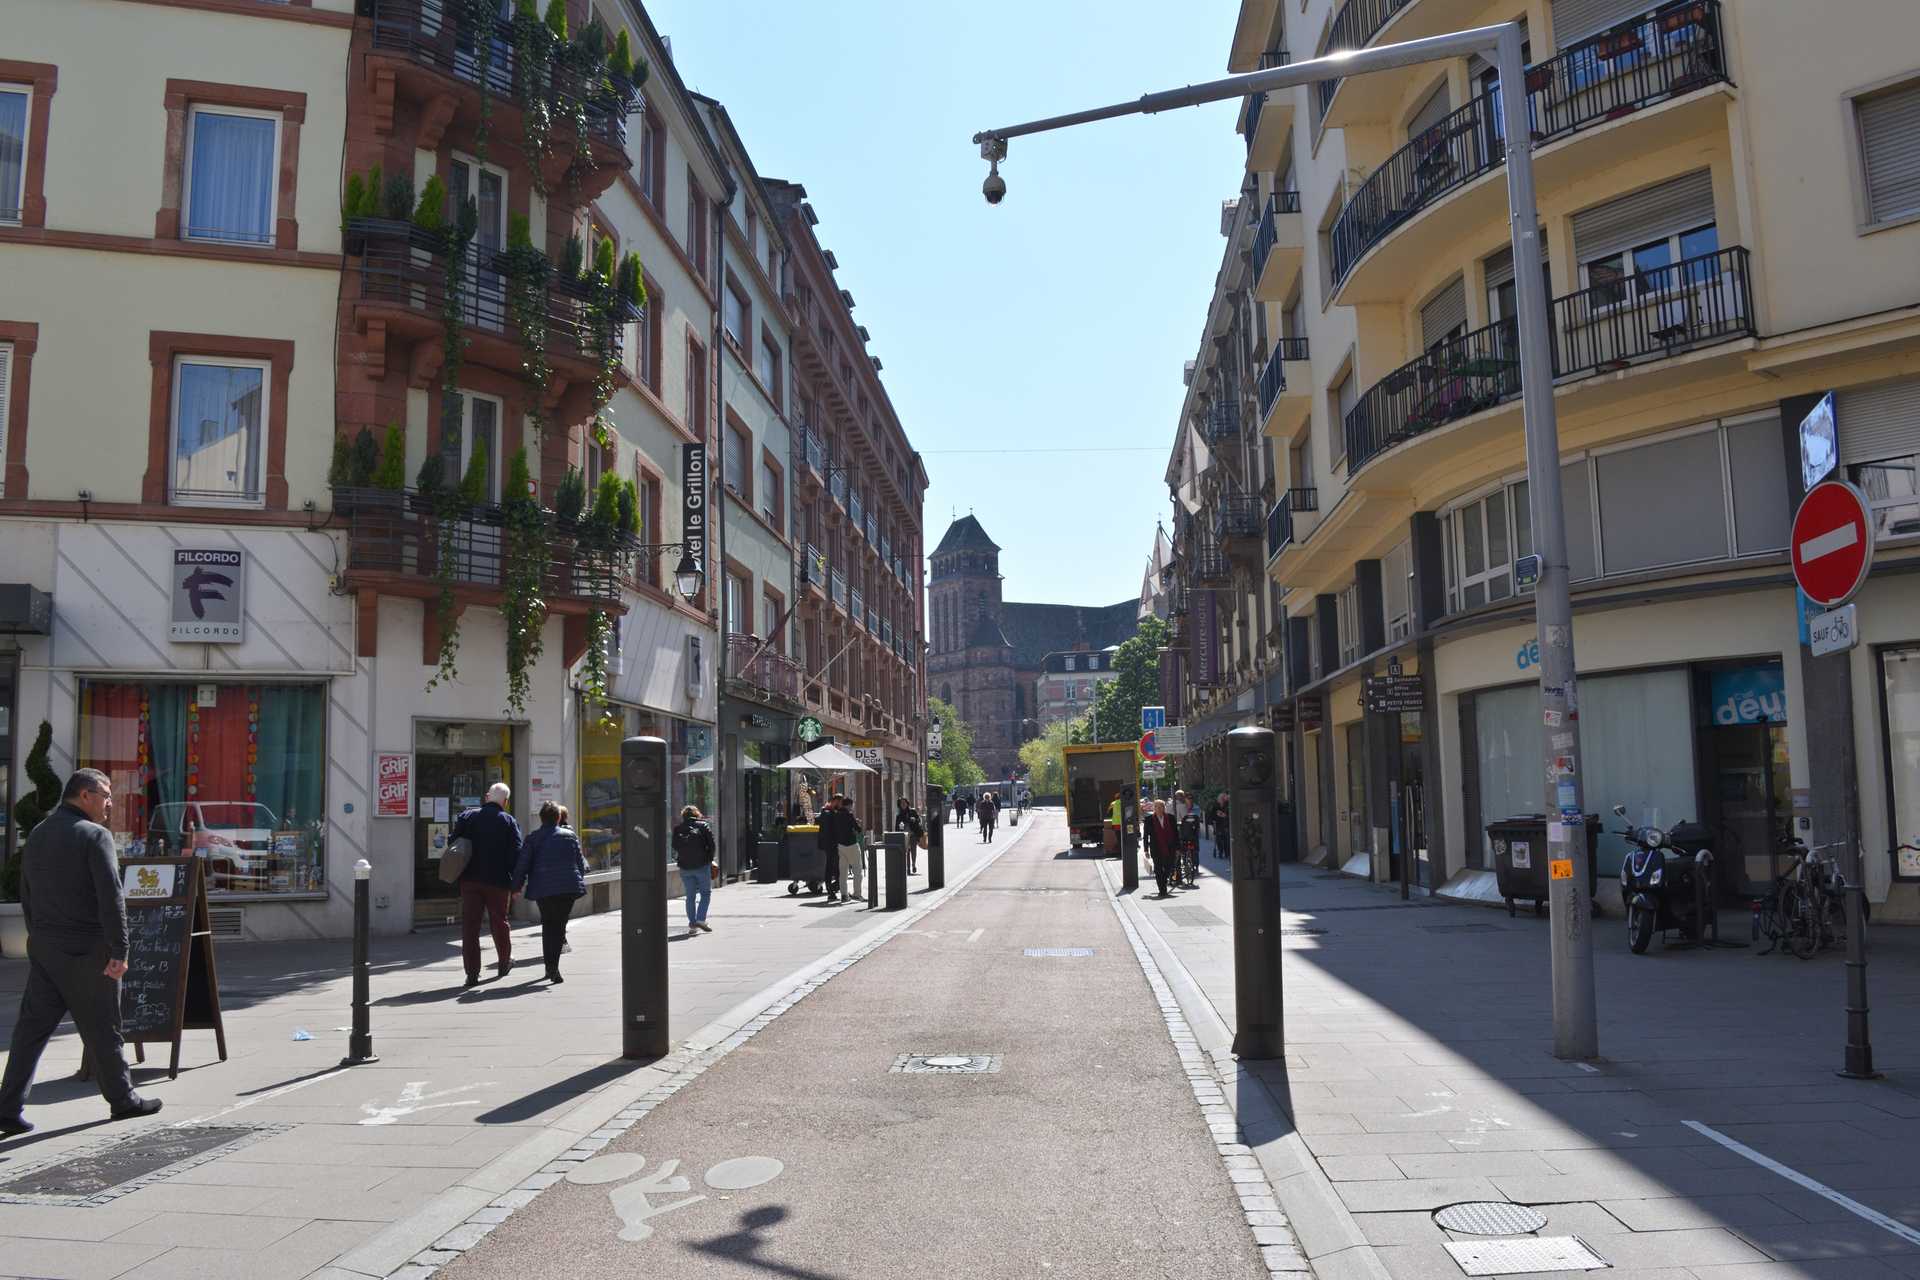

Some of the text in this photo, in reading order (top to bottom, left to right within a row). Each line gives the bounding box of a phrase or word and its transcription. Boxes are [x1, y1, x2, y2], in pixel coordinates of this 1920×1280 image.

[687, 449, 702, 509] Grillon
[687, 514, 702, 530] le
[177, 552, 239, 564] FILCORDO
[171, 625, 239, 636] FILCORDO
[1813, 627, 1830, 643] SAUF
[855, 749, 877, 759] DLS
[129, 888, 168, 897] SINGHA
